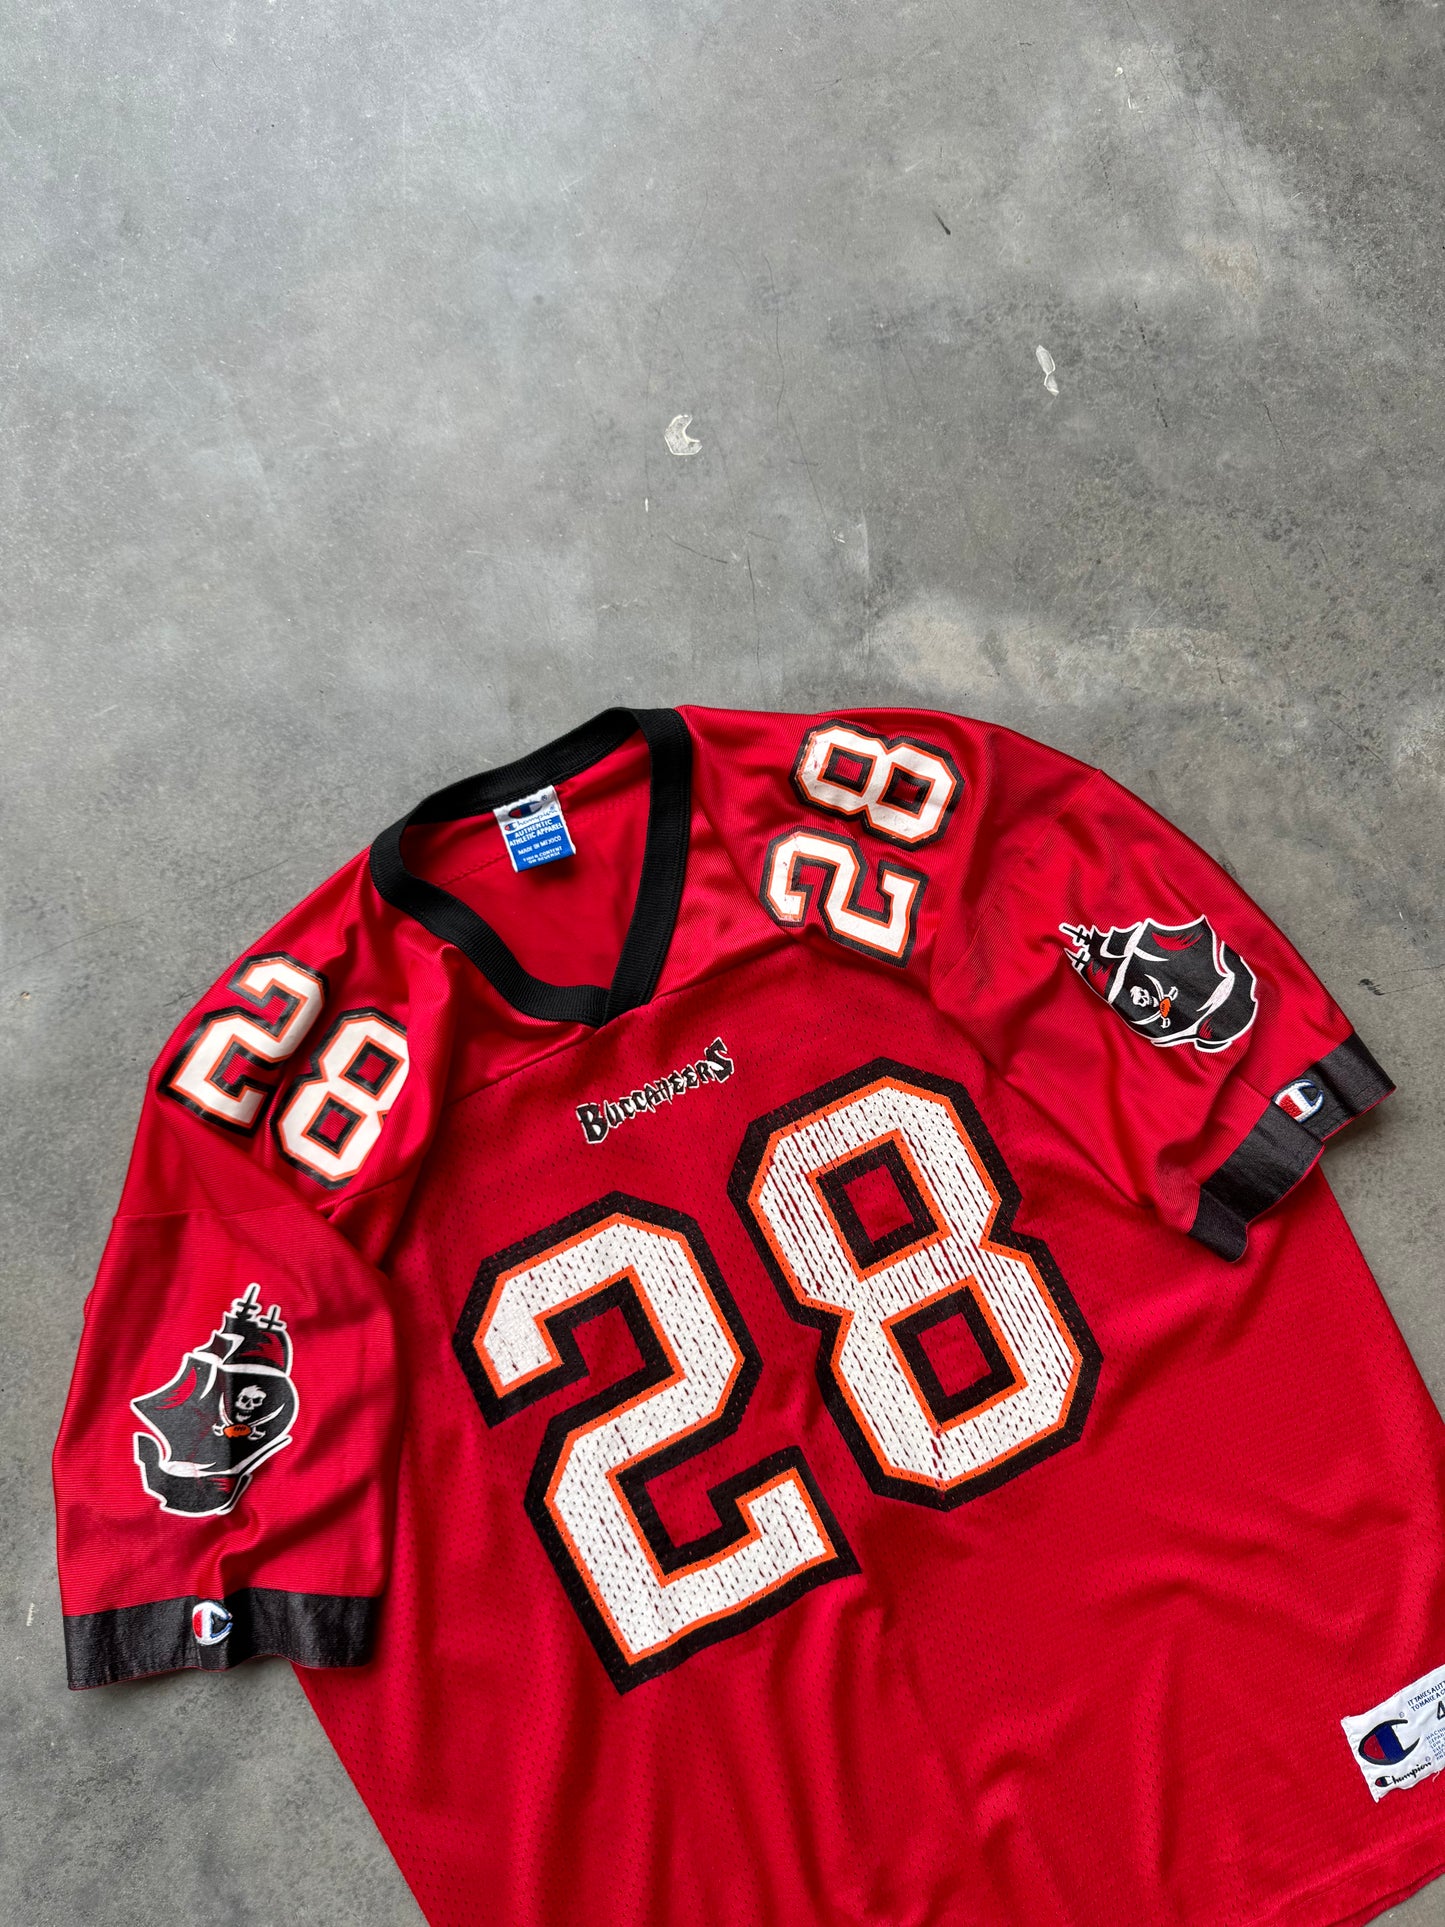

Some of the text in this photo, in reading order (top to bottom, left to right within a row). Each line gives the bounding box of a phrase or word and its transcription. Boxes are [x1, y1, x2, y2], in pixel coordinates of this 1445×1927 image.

[509, 822, 564, 847] ATHLETIC APPAREL
[514, 818, 553, 839] AUTHENTIC
[517, 845, 534, 856] MADE
[539, 834, 563, 848] MEXICO
[758, 717, 967, 970] 28
[156, 950, 411, 1191] 28
[452, 1055, 1105, 1696] 28
[1407, 1699, 1415, 1707] IT
[1414, 1689, 1432, 1703] TAKES
[1411, 1703, 1420, 1712] TO
[1419, 1695, 1436, 1707] MAKE
[1374, 1761, 1432, 1788] Champion
